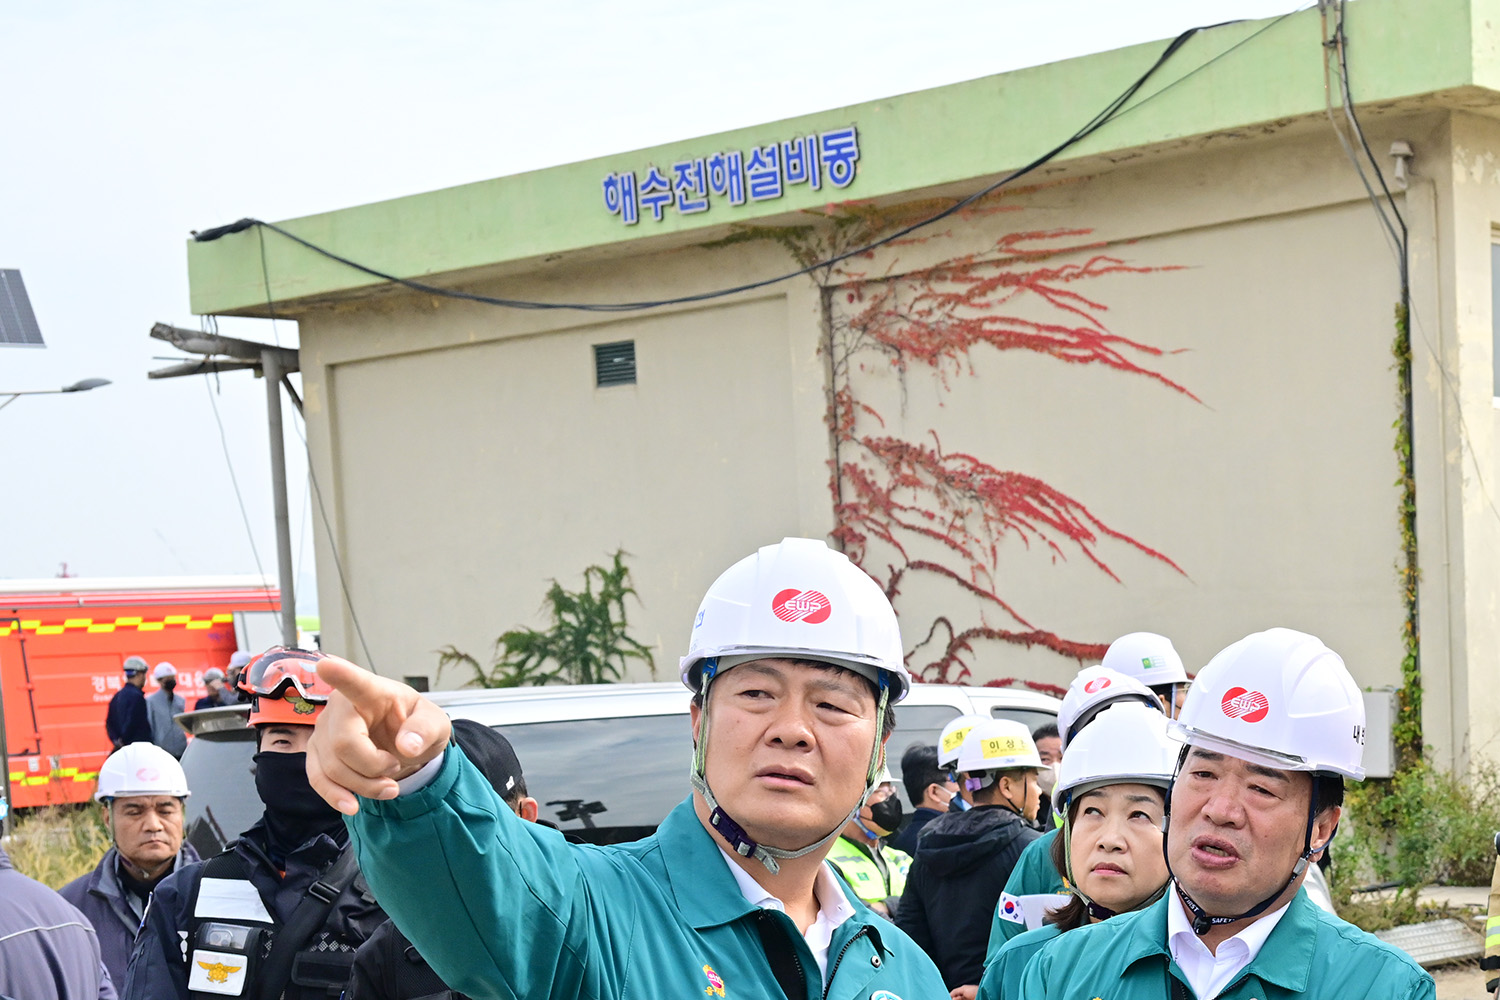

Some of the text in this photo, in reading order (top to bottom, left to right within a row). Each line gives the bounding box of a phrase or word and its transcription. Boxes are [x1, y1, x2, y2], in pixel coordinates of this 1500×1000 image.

[602, 127, 860, 225] 해수전해설비동
[784, 600, 822, 612] EWP
[1230, 697, 1261, 711] EWP
[1184, 896, 1199, 912] FIRST
